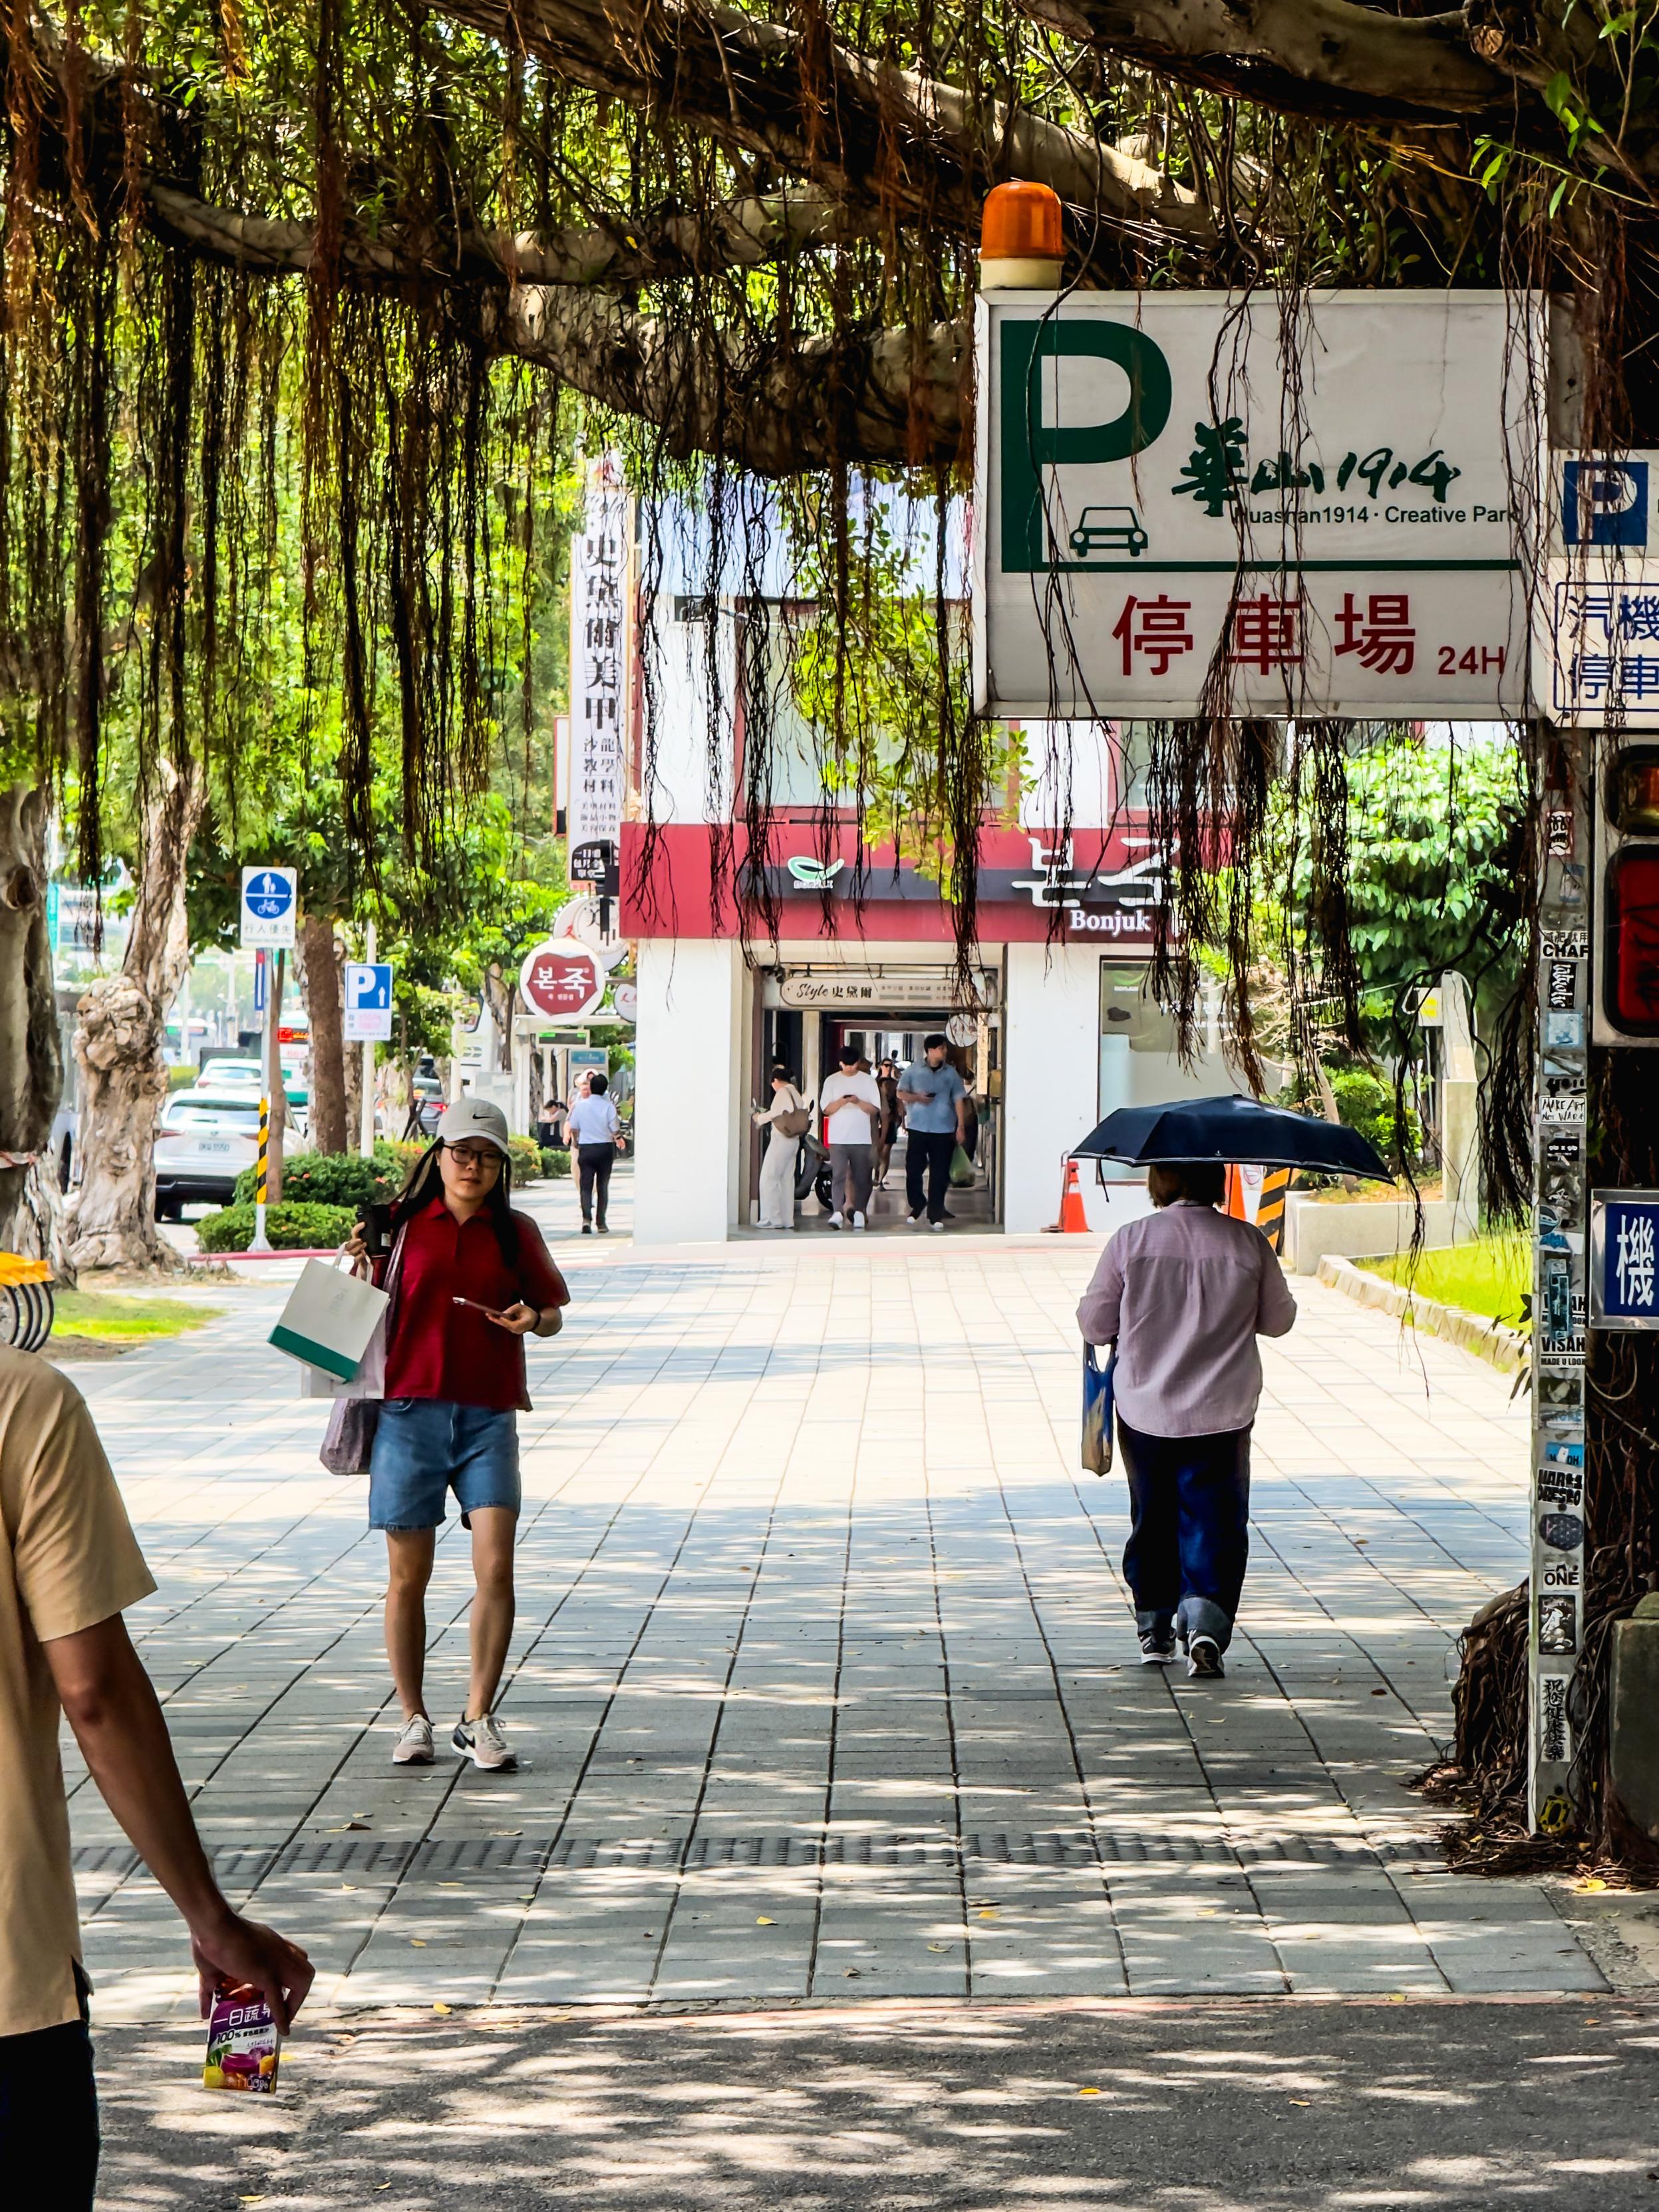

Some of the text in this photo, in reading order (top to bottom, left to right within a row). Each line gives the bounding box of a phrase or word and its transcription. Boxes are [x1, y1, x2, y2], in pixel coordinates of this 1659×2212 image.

[1000, 319, 1172, 573] P
[1385, 505, 1466, 523] Creative
[1112, 592, 1505, 676] 停車場 24H
[1070, 908, 1151, 938] Bonjuk
[347, 966, 377, 1009] P
[533, 966, 592, 1000] 본죽
[796, 983, 830, 1000] Style
[1616, 1214, 1655, 1306] 機
[1544, 1572, 1580, 1586] ONE
